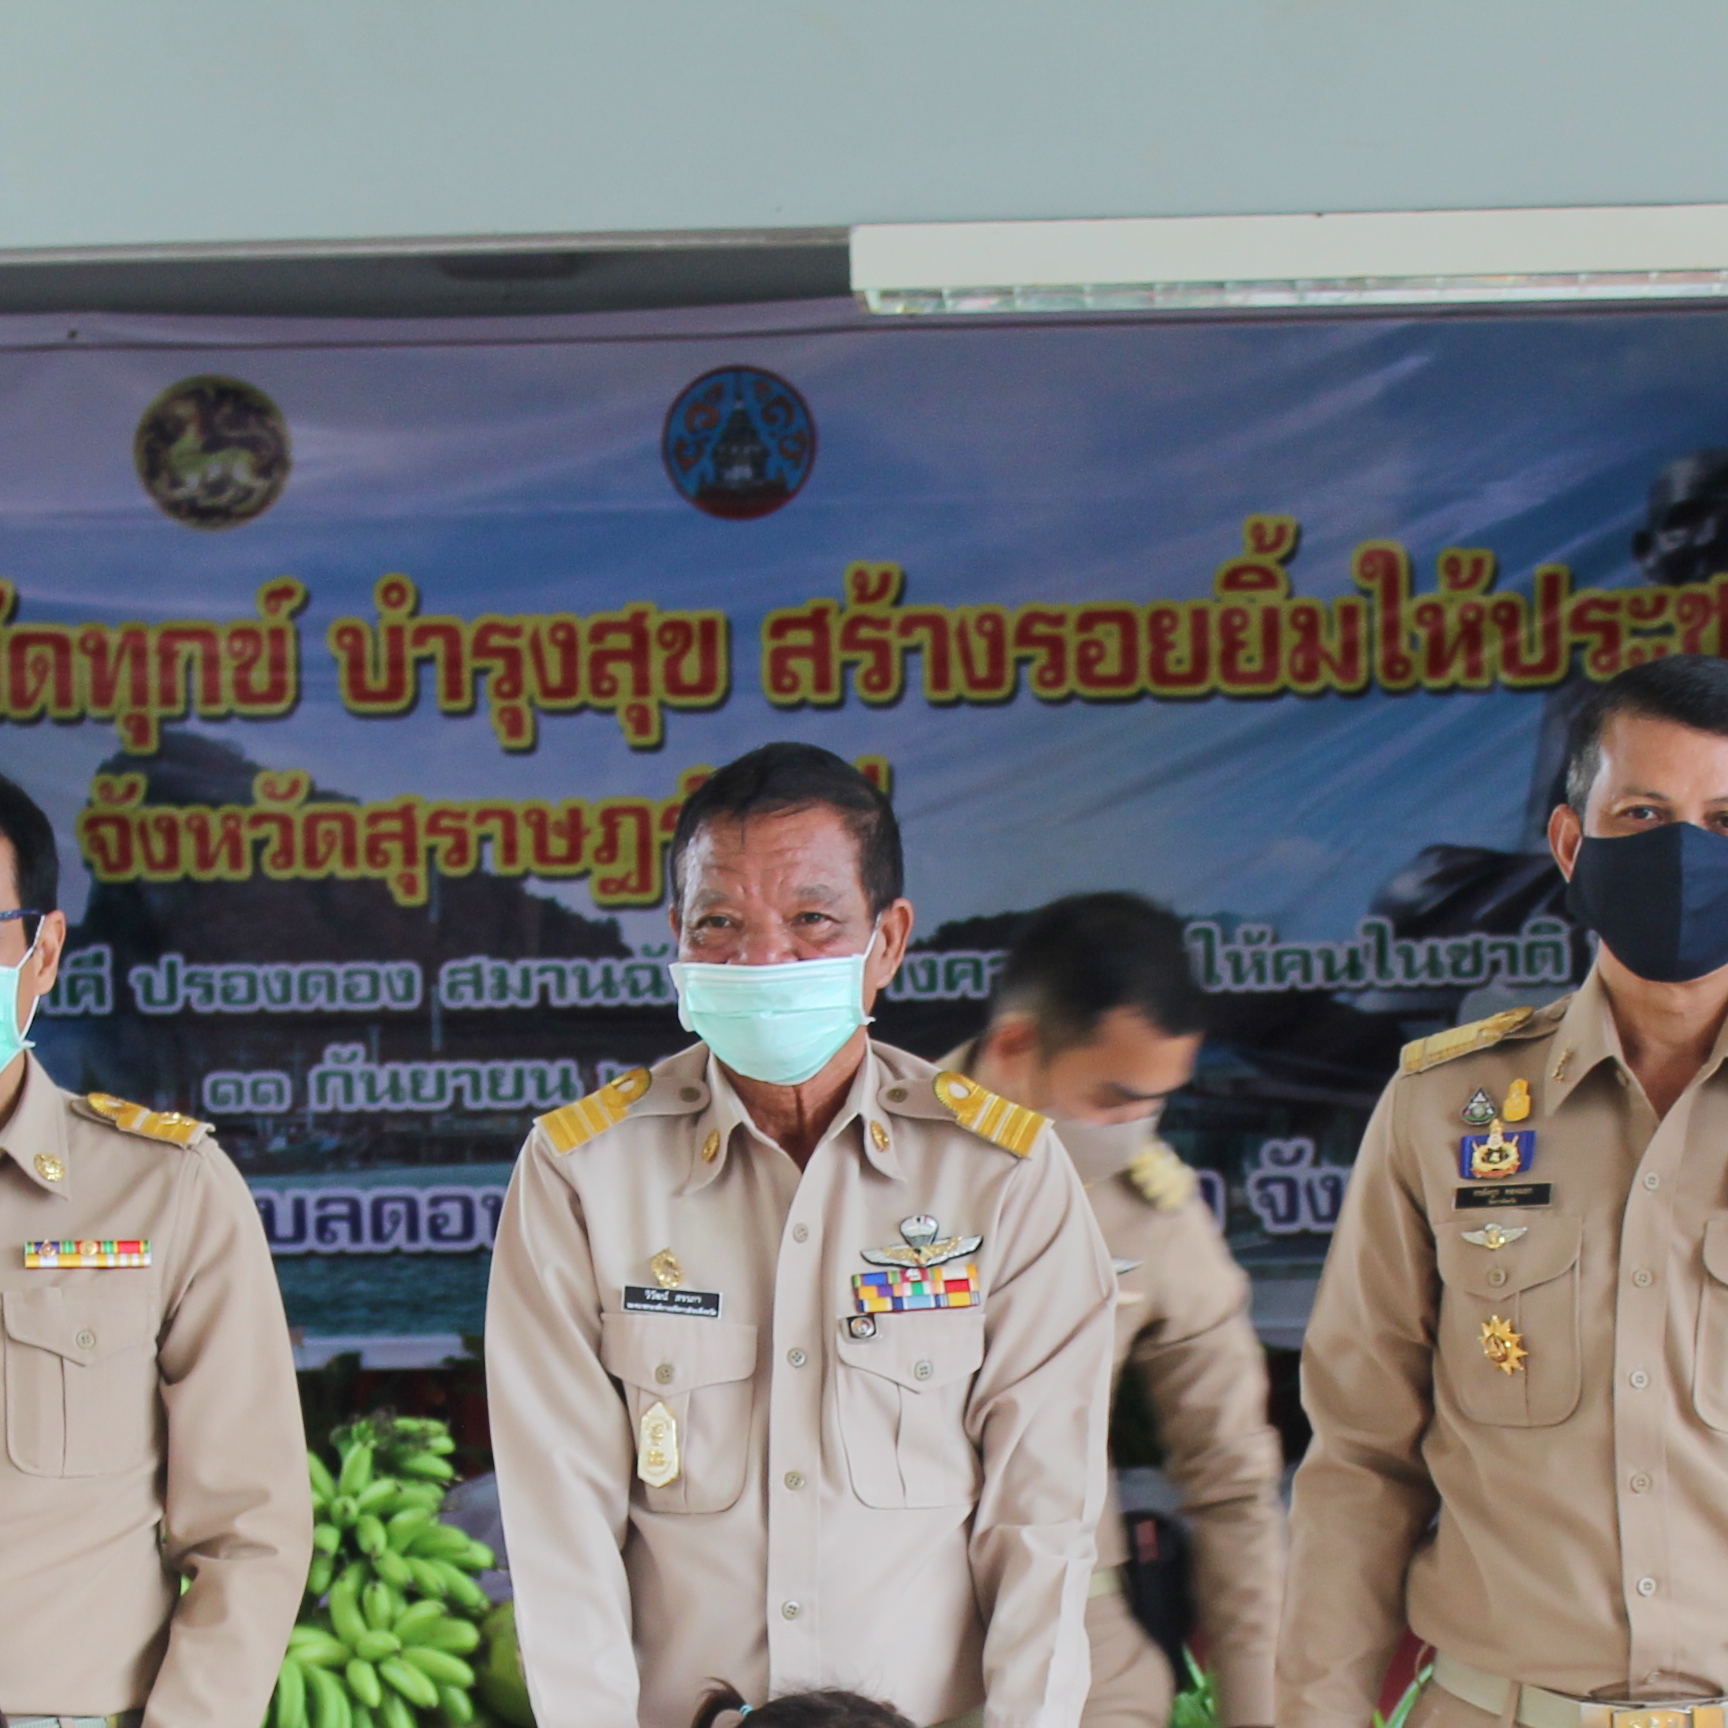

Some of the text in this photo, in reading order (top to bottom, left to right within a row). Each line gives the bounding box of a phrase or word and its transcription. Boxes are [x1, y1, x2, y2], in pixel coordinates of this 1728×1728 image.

[329, 573, 727, 750] บำรุงสุข
[129, 955, 422, 1014] ปรองดอง
[442, 942, 676, 1008] สมานฉั
[1185, 918, 1570, 993] ให้คนในชาติ
[204, 1069, 294, 1113] ๑๑
[309, 1043, 584, 1111] กันยายน
